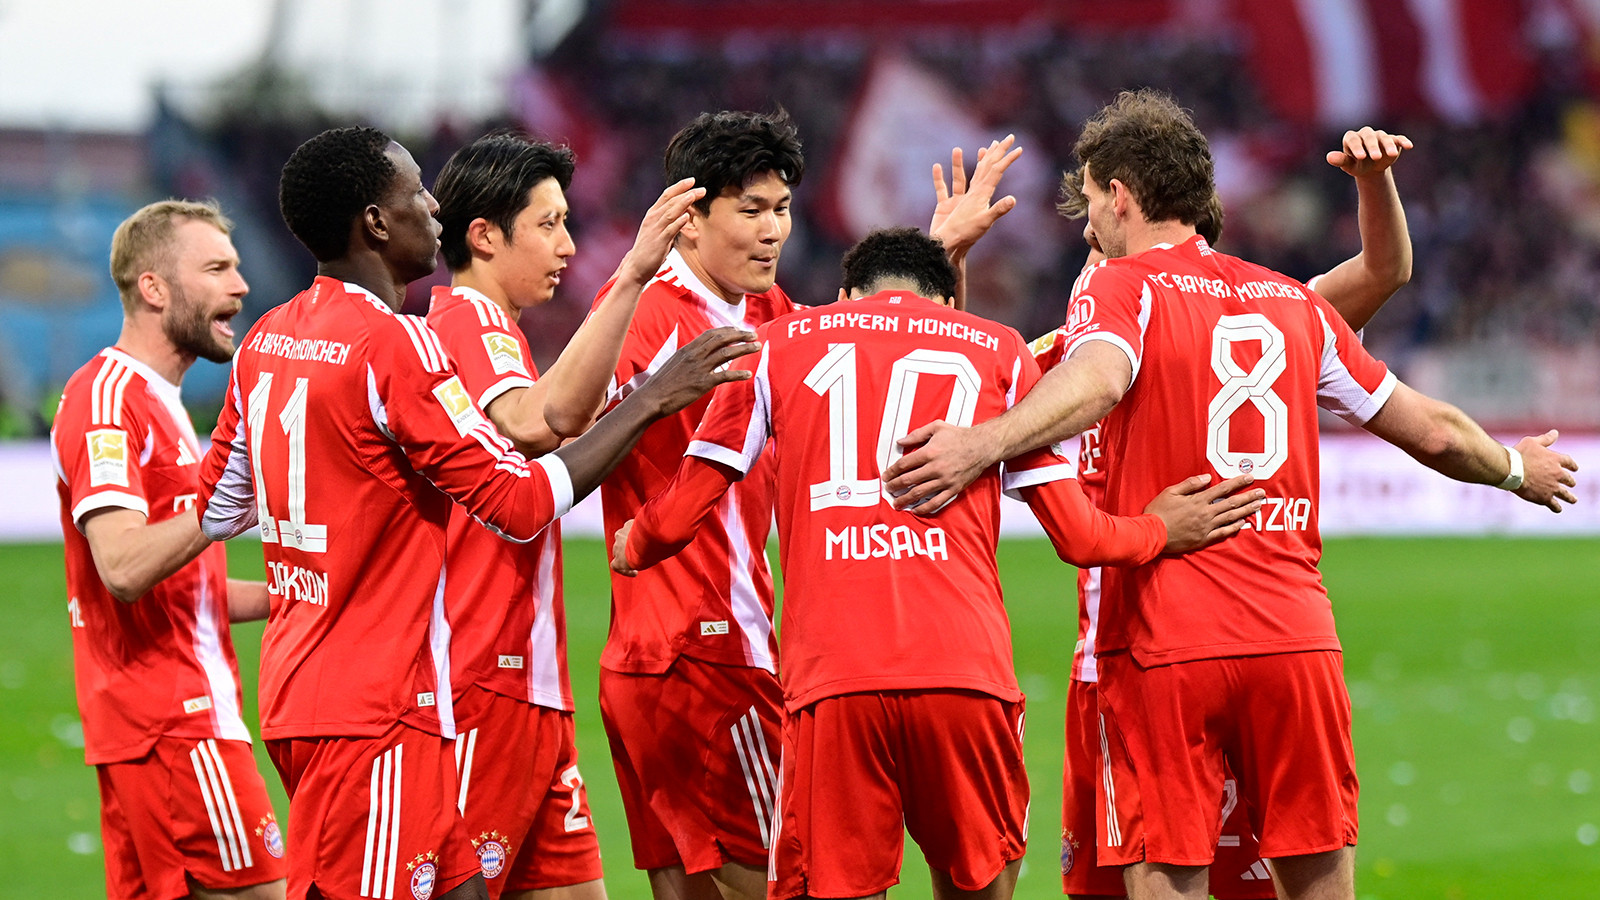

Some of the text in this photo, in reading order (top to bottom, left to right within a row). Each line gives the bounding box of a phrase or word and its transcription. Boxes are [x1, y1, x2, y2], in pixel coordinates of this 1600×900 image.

[788, 313, 999, 351] FC BAYERN MÜNCHEN
[1148, 272, 1174, 289] FC
[247, 372, 328, 553] 11
[802, 343, 982, 514] 10
[1206, 313, 1288, 480] 8
